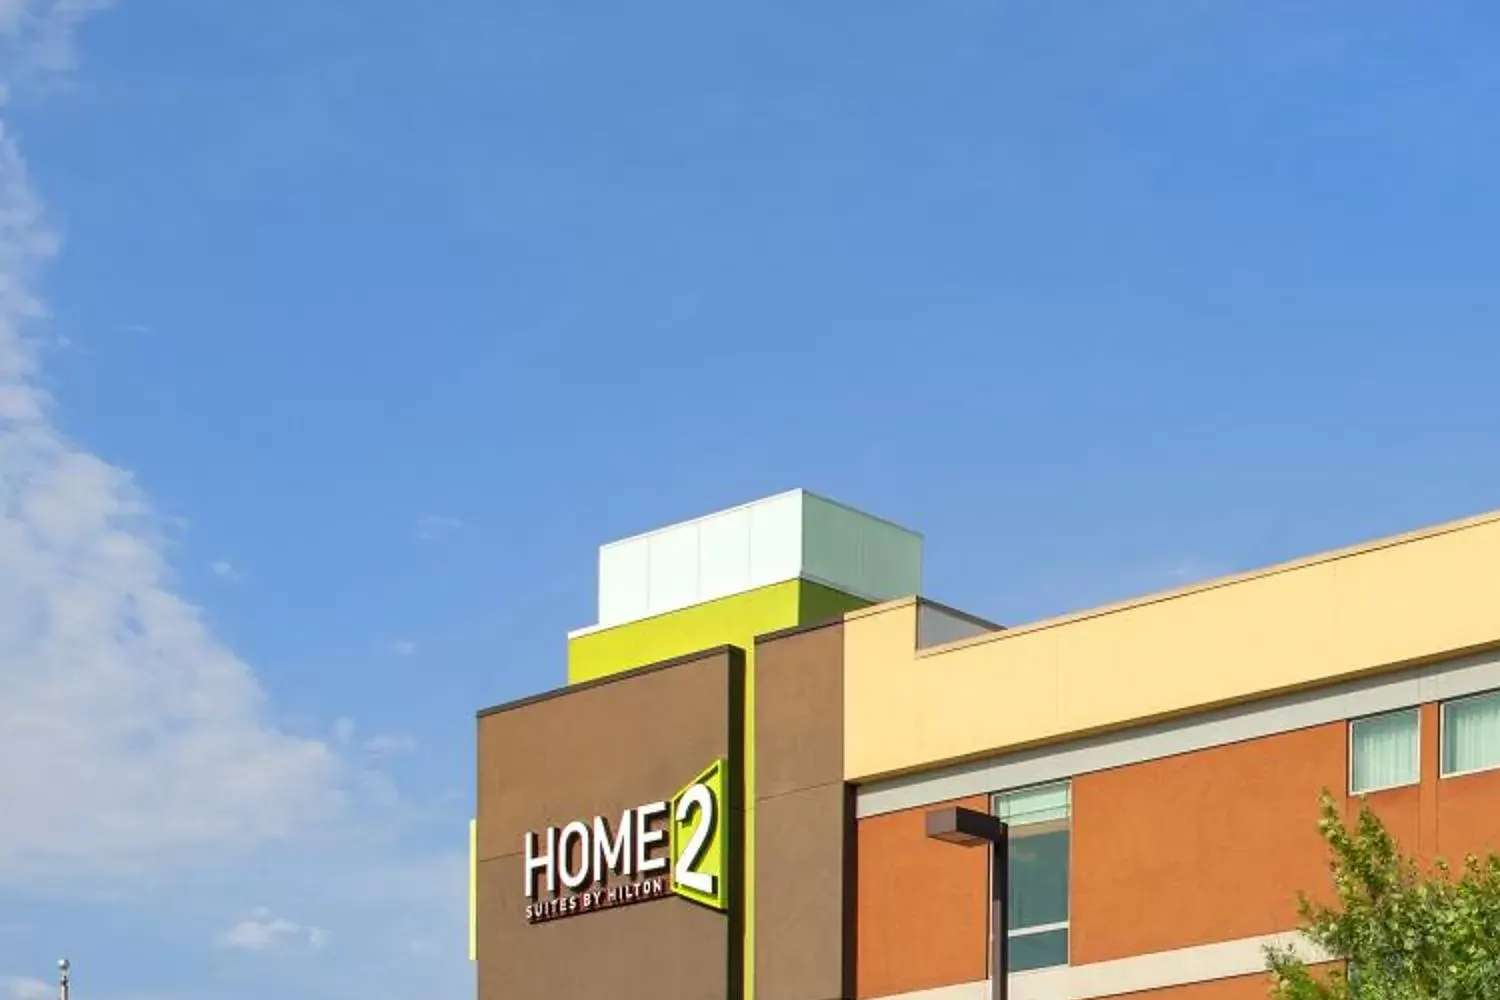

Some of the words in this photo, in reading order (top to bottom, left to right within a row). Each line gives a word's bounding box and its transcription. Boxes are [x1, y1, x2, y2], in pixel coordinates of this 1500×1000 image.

[525, 801, 667, 897] HOME
[525, 895, 576, 919] SUITES
[583, 891, 601, 907] BY
[608, 879, 662, 900] HILTON
